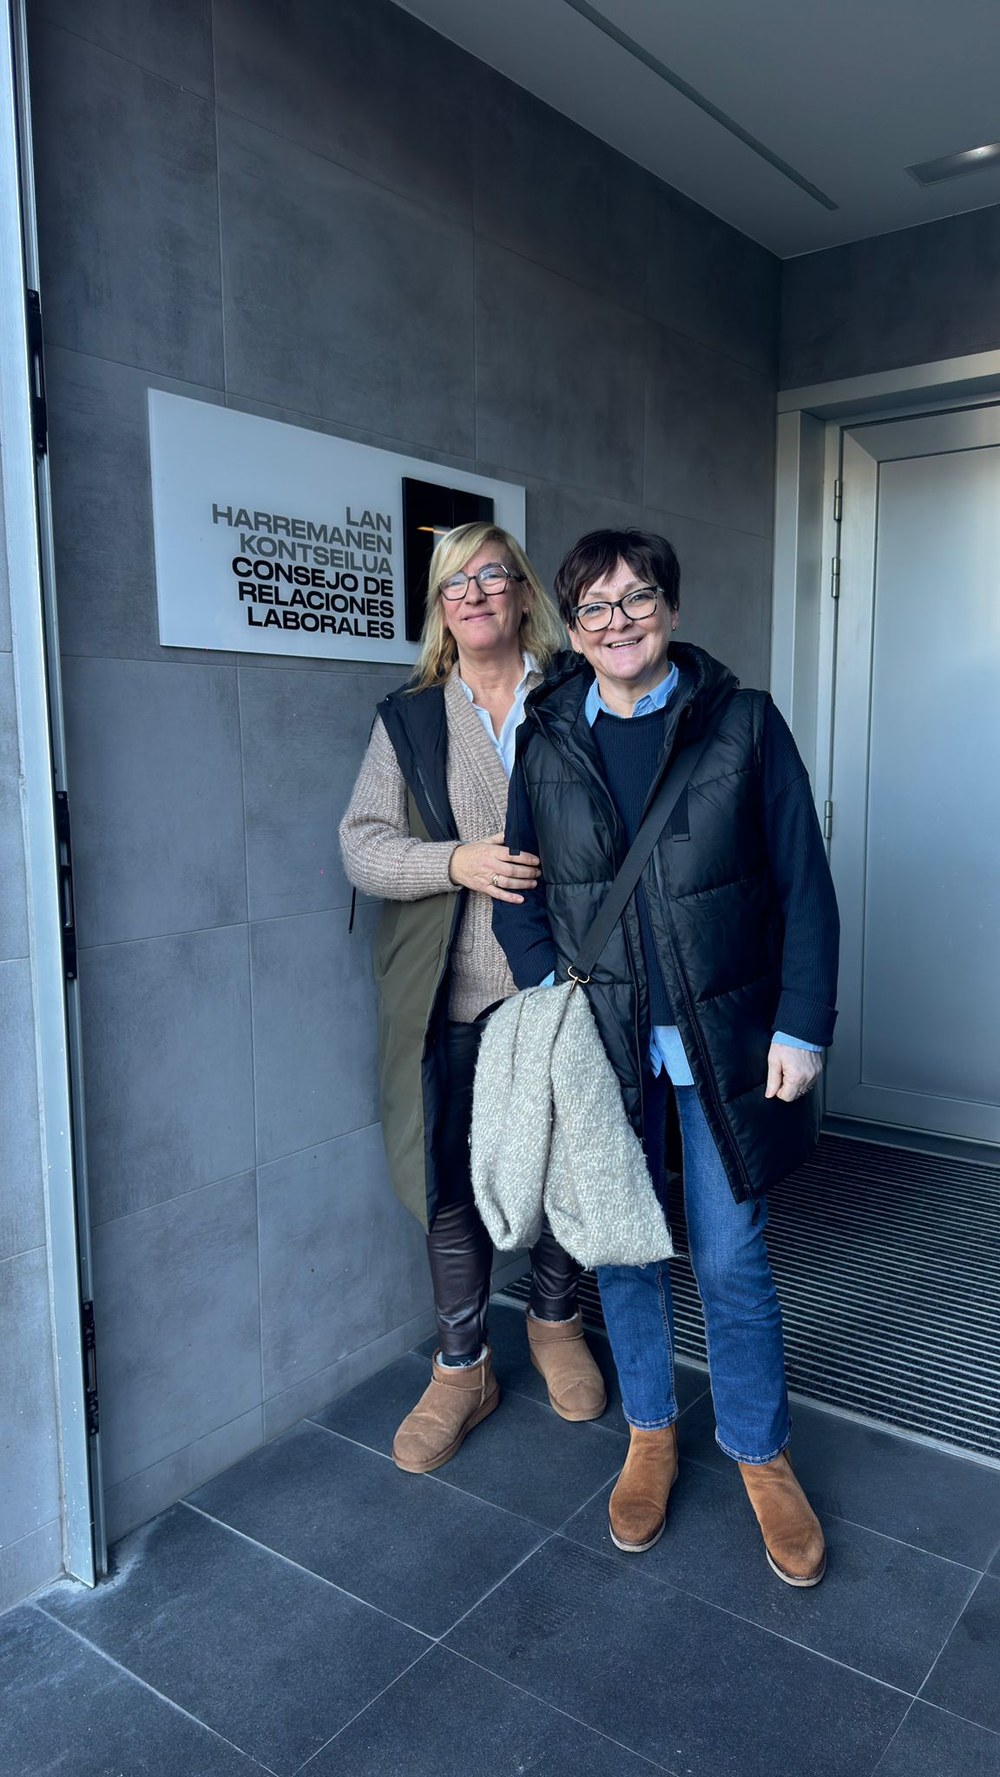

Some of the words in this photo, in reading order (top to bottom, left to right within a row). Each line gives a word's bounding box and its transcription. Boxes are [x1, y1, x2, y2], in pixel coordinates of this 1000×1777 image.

[212, 503, 393, 555] HARREMANEN
[346, 506, 392, 533] LAN
[240, 533, 394, 576] KONTSEILUA
[232, 556, 359, 593] CONSEJO
[363, 576, 394, 598] DE
[238, 581, 394, 619] RELACIONES
[247, 606, 395, 640] LABORALES
